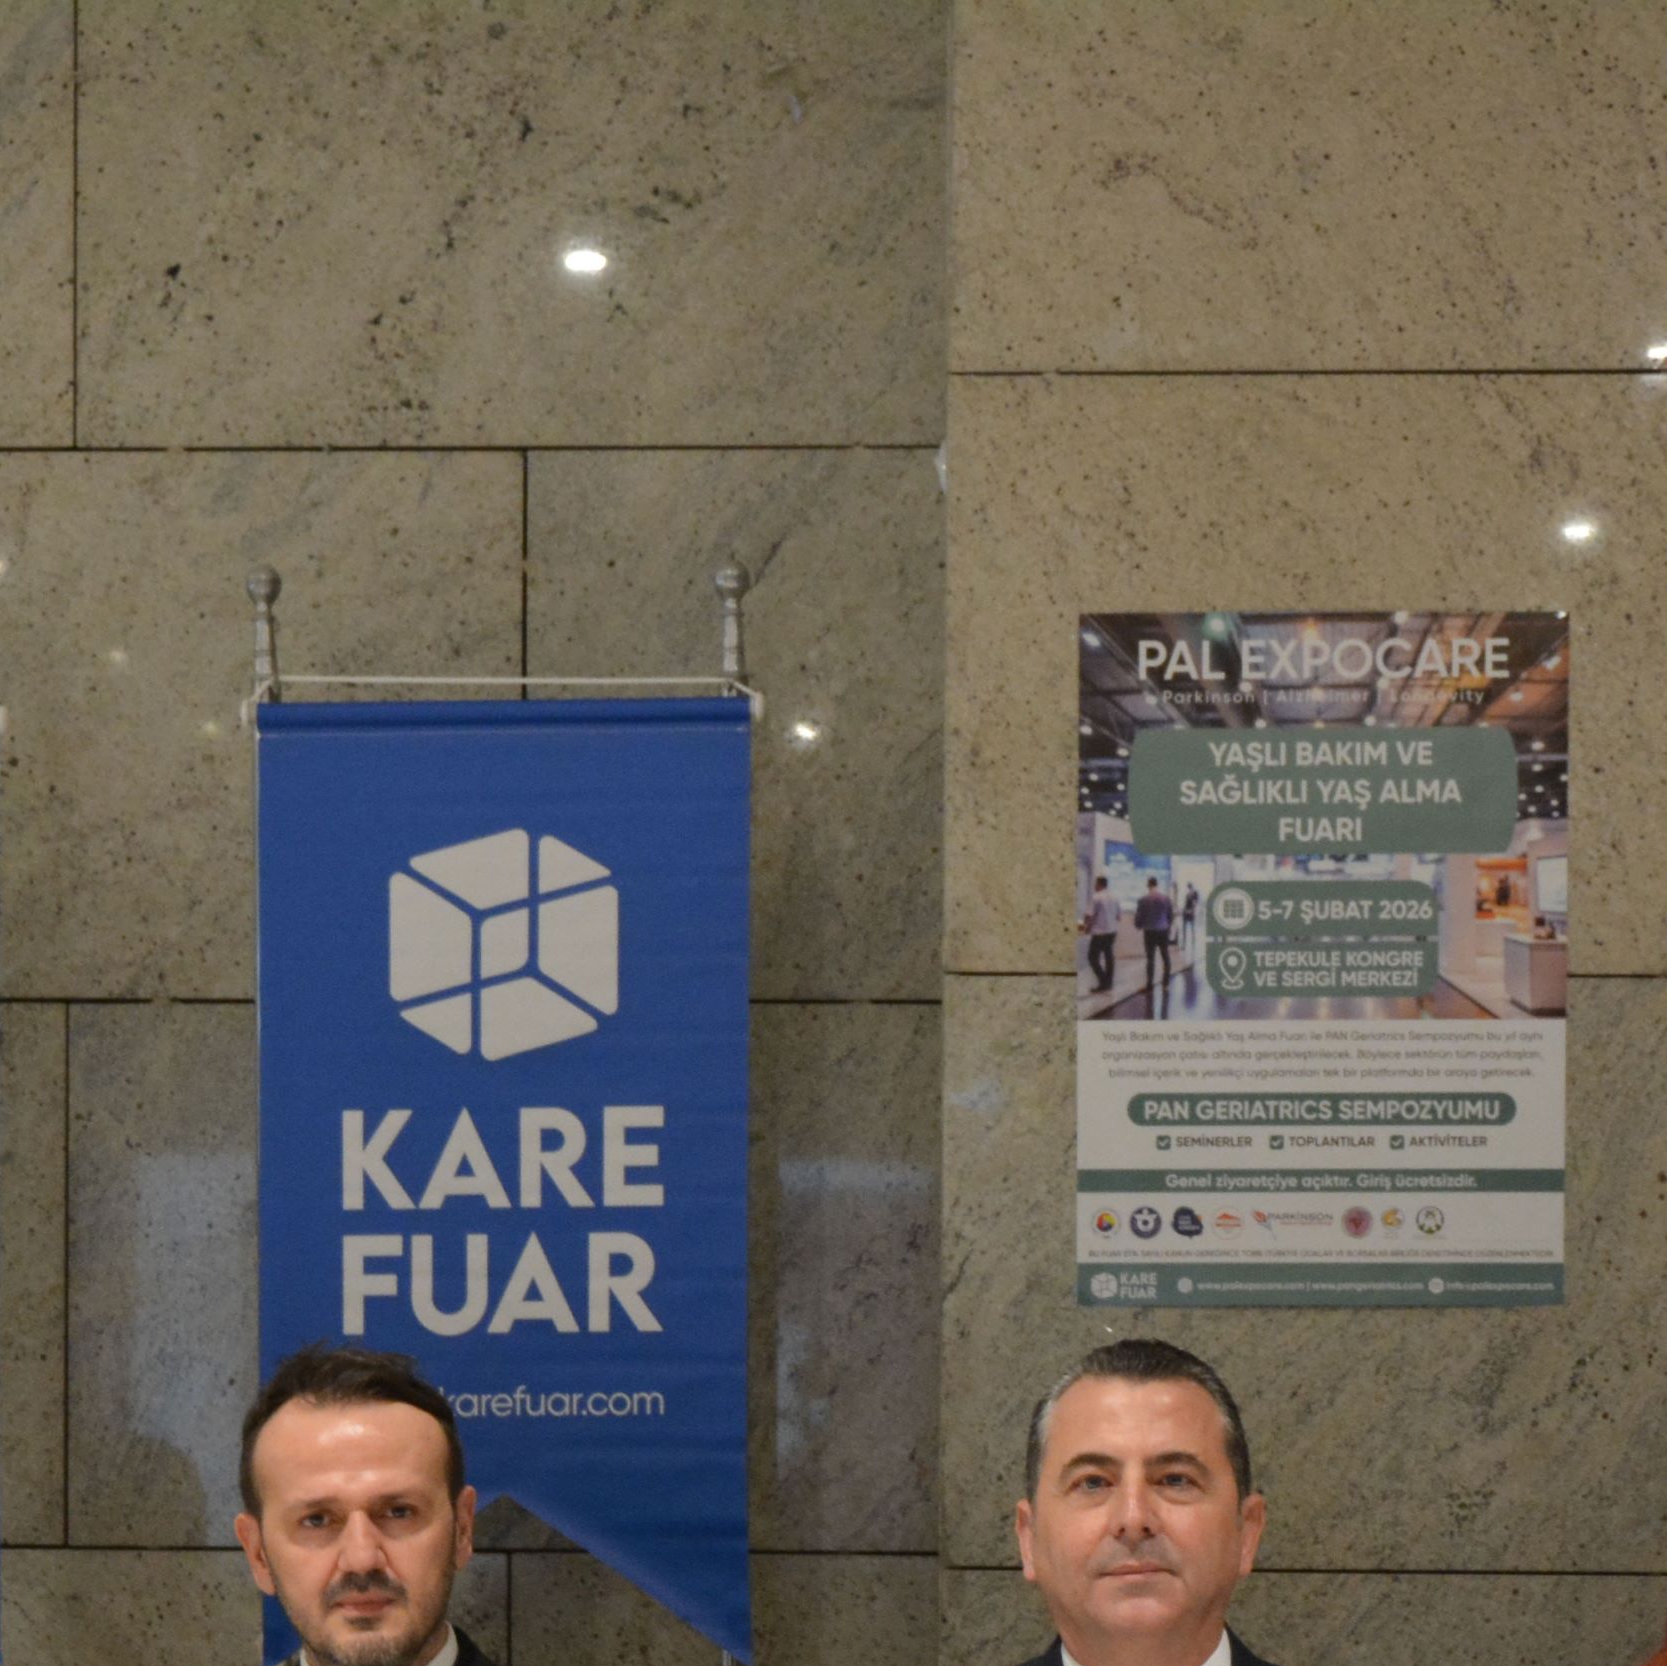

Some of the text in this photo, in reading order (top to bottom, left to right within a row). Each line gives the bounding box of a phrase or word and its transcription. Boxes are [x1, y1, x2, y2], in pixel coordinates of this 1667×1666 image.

[1137, 636, 1511, 681] PAL EXPOCARE
[1161, 689, 1255, 704] Parkinson
[1209, 741, 1433, 773] YAŞLI BAKIM VE
[1180, 774, 1462, 811] SAĞLIKLI YAŞ ALMA
[1278, 817, 1362, 843] FUARI
[1258, 900, 1433, 926] 5-7 ŞUBAT 2026
[1254, 951, 1425, 968] TEPEKULE KONGRE
[1253, 967, 1419, 987] VE SERGİ MERKEZİ
[1143, 1100, 1501, 1121] PAN GERIATRICS SEMPOZYUMU
[1176, 1134, 1253, 1148] SEMİNERLER
[1289, 1135, 1375, 1148] TOPLANTILAR
[1409, 1134, 1489, 1148] AKTİVİTELER
[340, 1105, 665, 1211] KARE
[1165, 1173, 1479, 1192] Genel ziyaretçiye açıktır. Giriş ücretsizdir.
[340, 1230, 664, 1338] FUAR
[1120, 1272, 1158, 1286] KARE
[1120, 1286, 1158, 1299] FUAR
